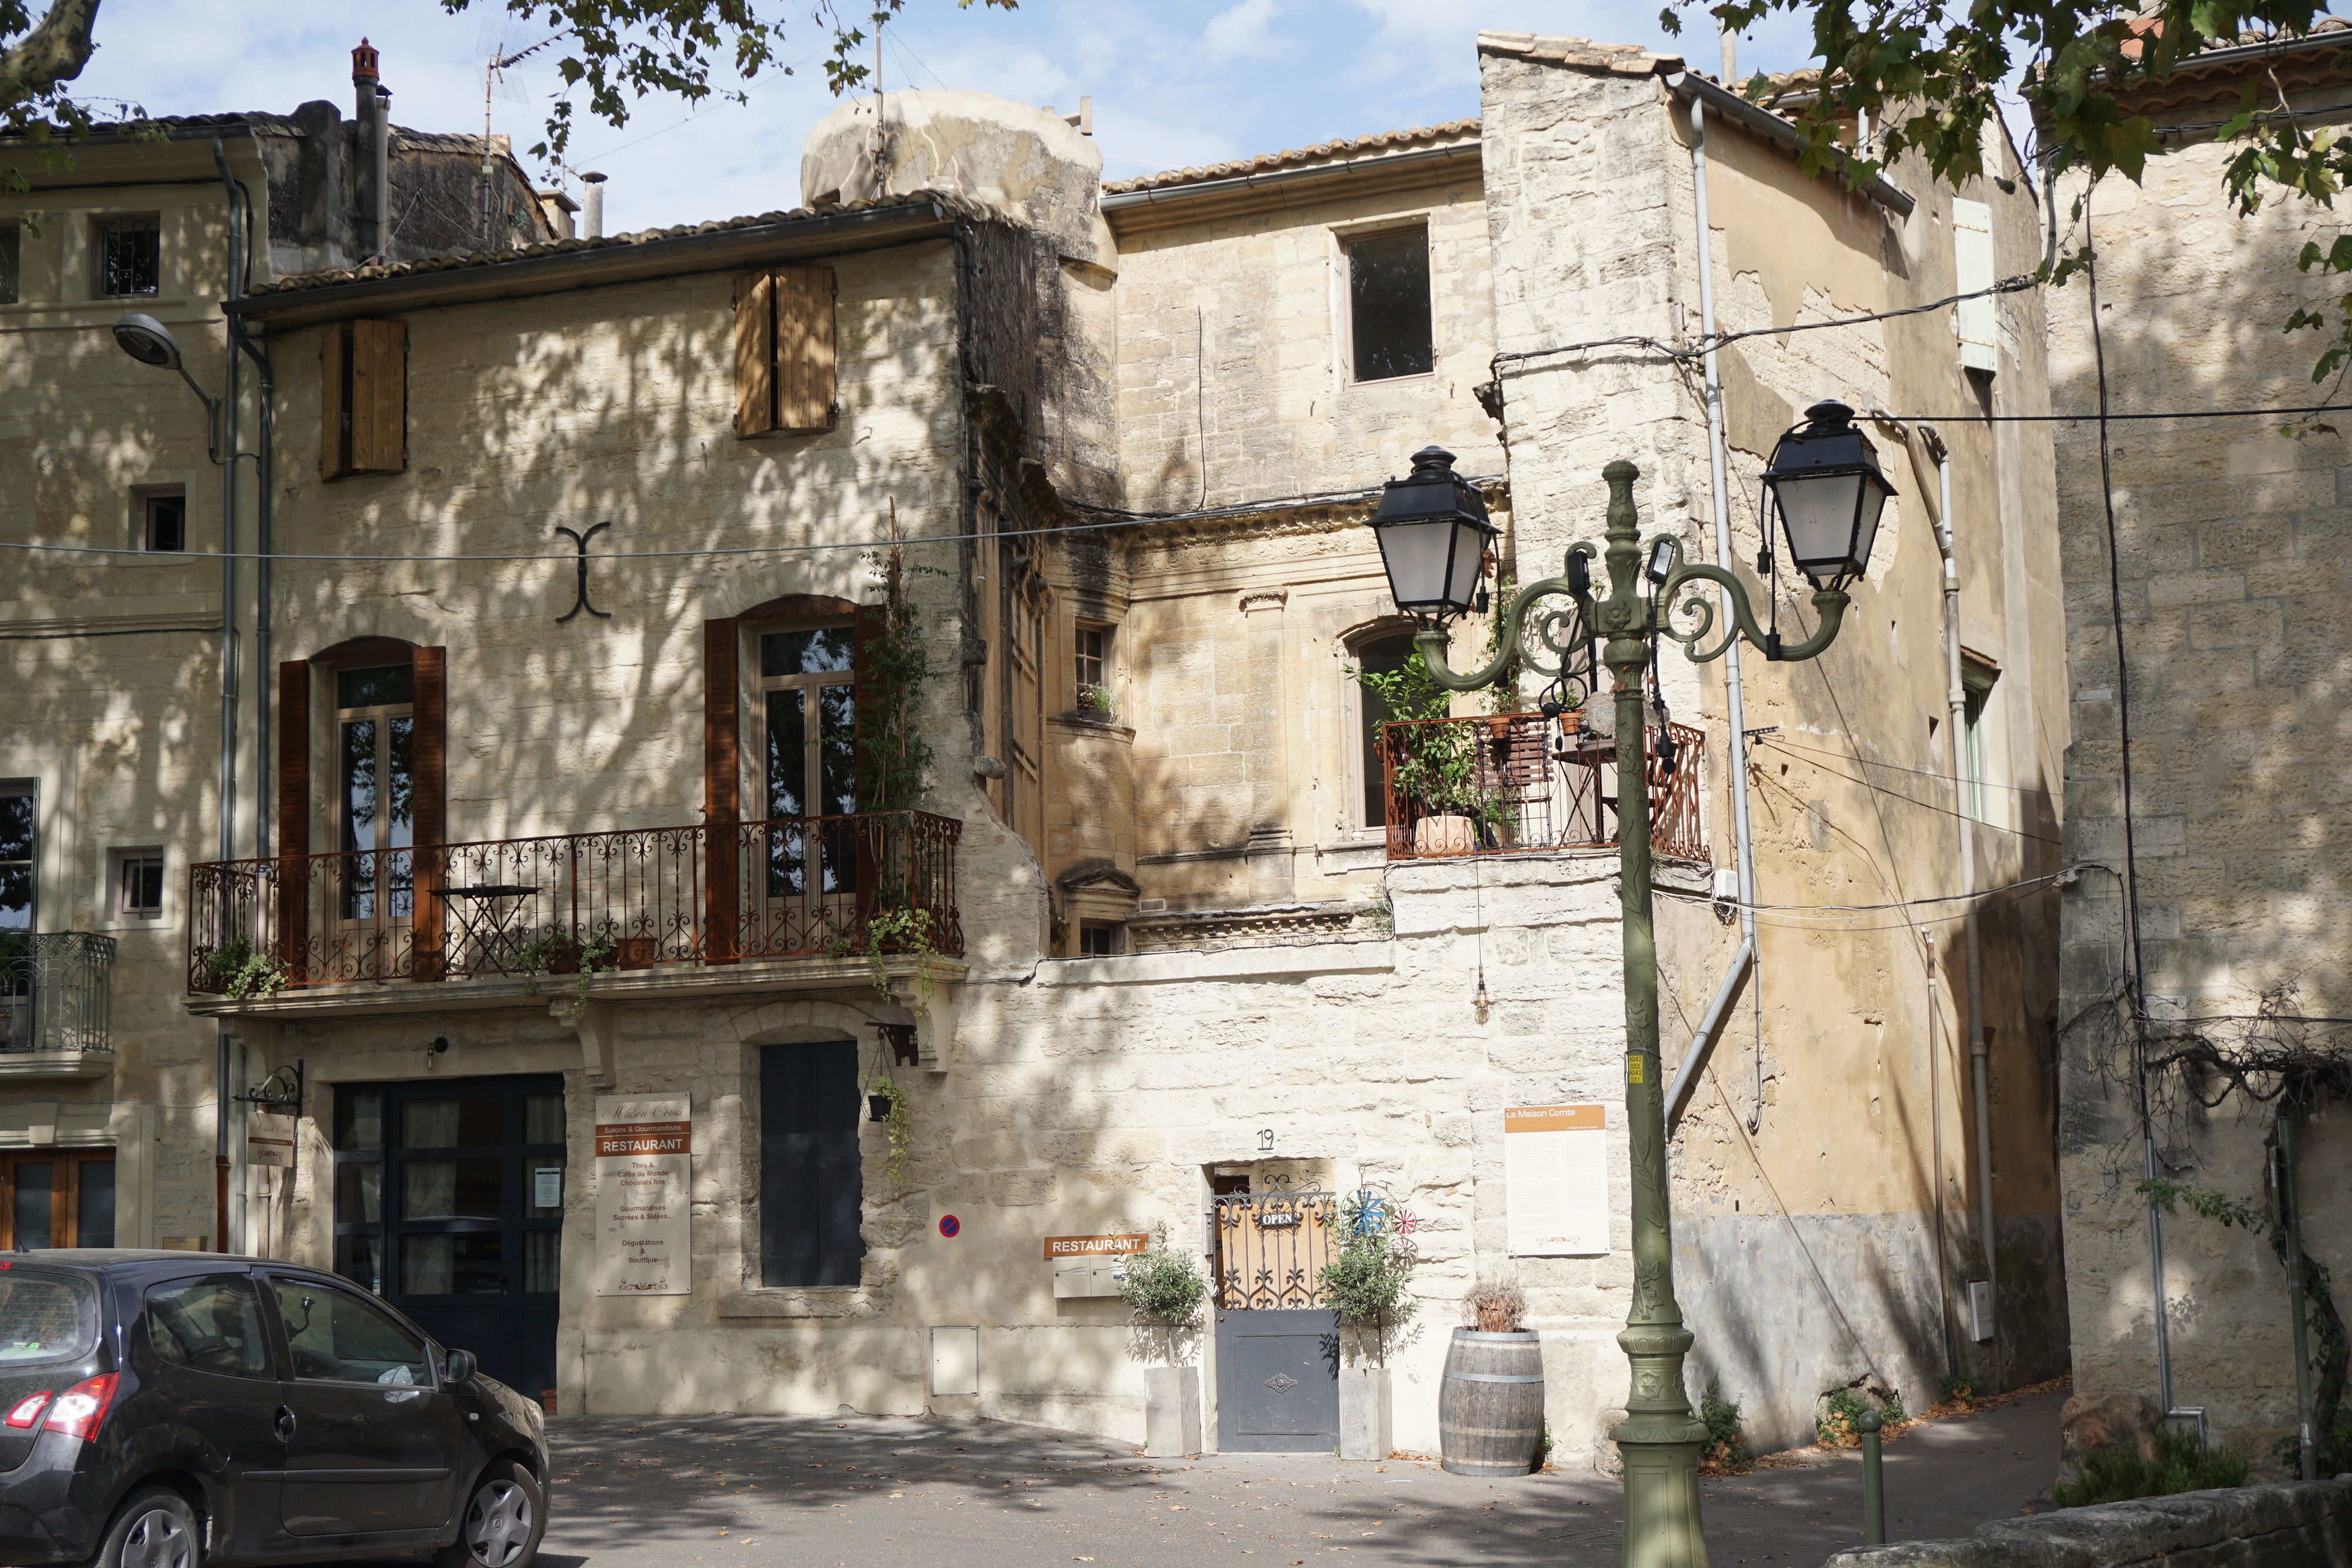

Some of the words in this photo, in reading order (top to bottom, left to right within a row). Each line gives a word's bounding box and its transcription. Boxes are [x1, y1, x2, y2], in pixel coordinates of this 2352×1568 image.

[599, 1101, 647, 1121] Maison
[647, 1098, 685, 1120] Comte
[1506, 1110, 1516, 1118] La
[1518, 1109, 1547, 1118] Maison
[1549, 1108, 1575, 1116] Comte
[1257, 1128, 1274, 1149] 19
[603, 1139, 683, 1152] RESTAURANT
[1262, 1213, 1292, 1225] OPEN
[1053, 1238, 1141, 1252] RESTAURANT
